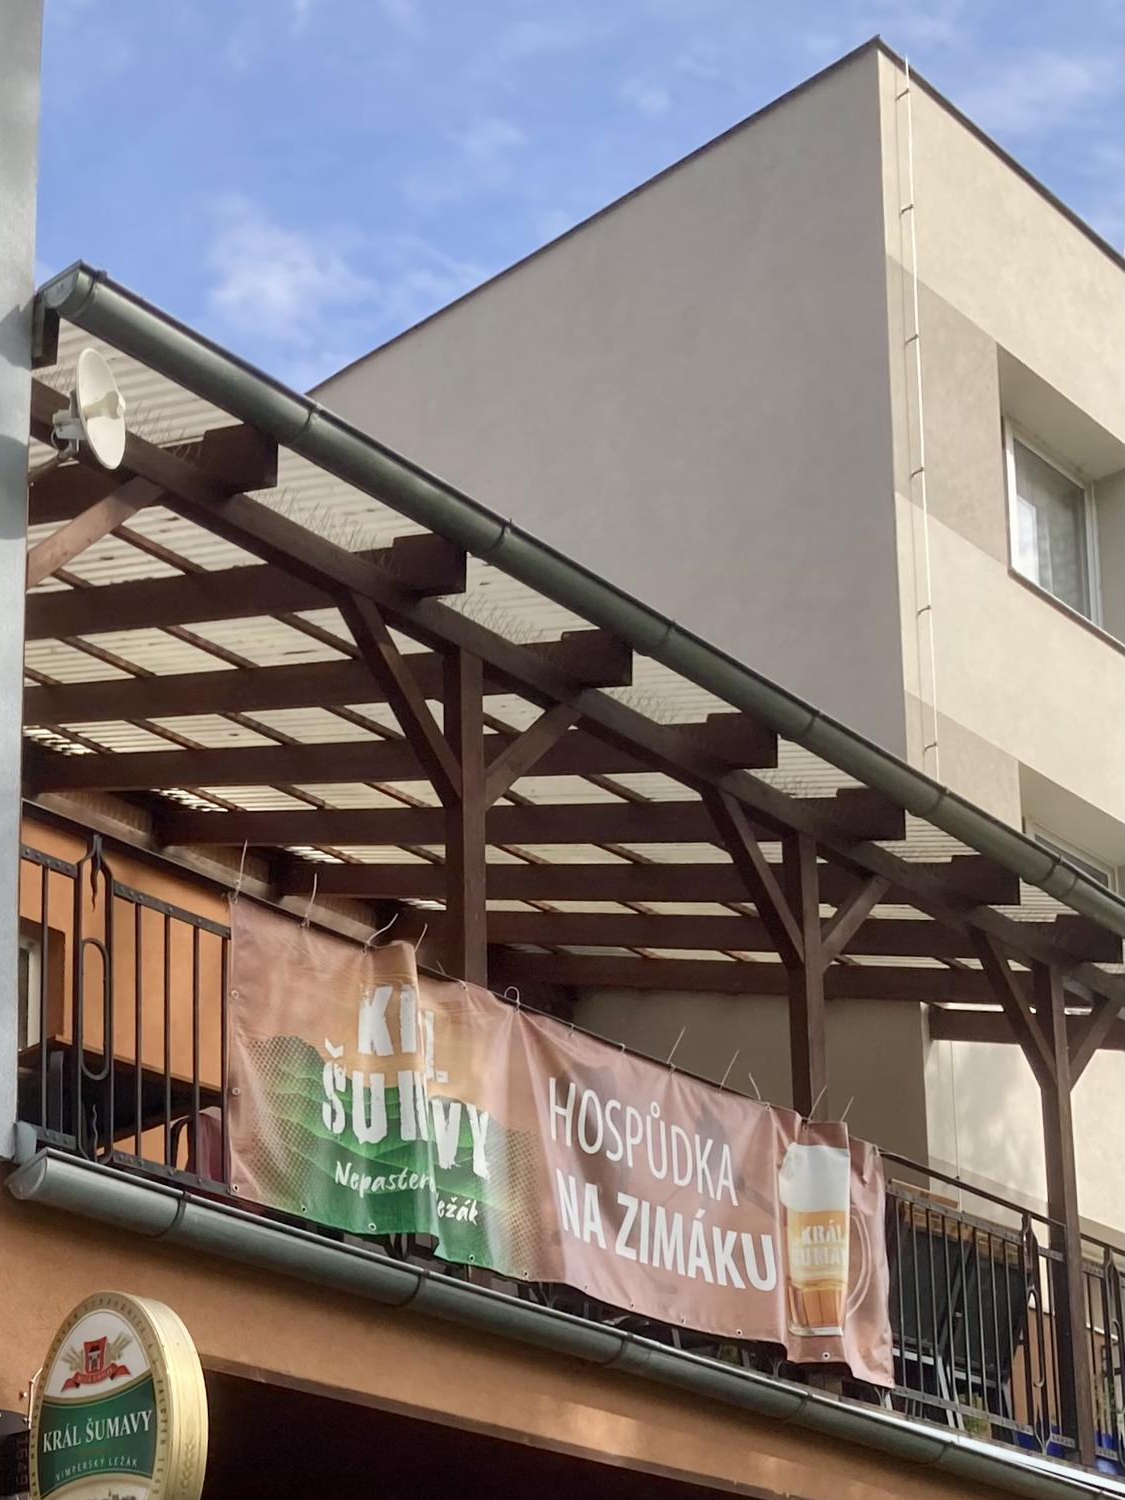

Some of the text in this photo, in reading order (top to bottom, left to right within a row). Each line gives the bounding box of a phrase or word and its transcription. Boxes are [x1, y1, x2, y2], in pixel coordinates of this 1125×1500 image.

[549, 1077, 739, 1206] HOSPŮDKA
[435, 1191, 478, 1225] ežák
[556, 1168, 777, 1291] NA ZIMÁKU
[43, 1409, 153, 1453] KRÁL ŠUMAVY
